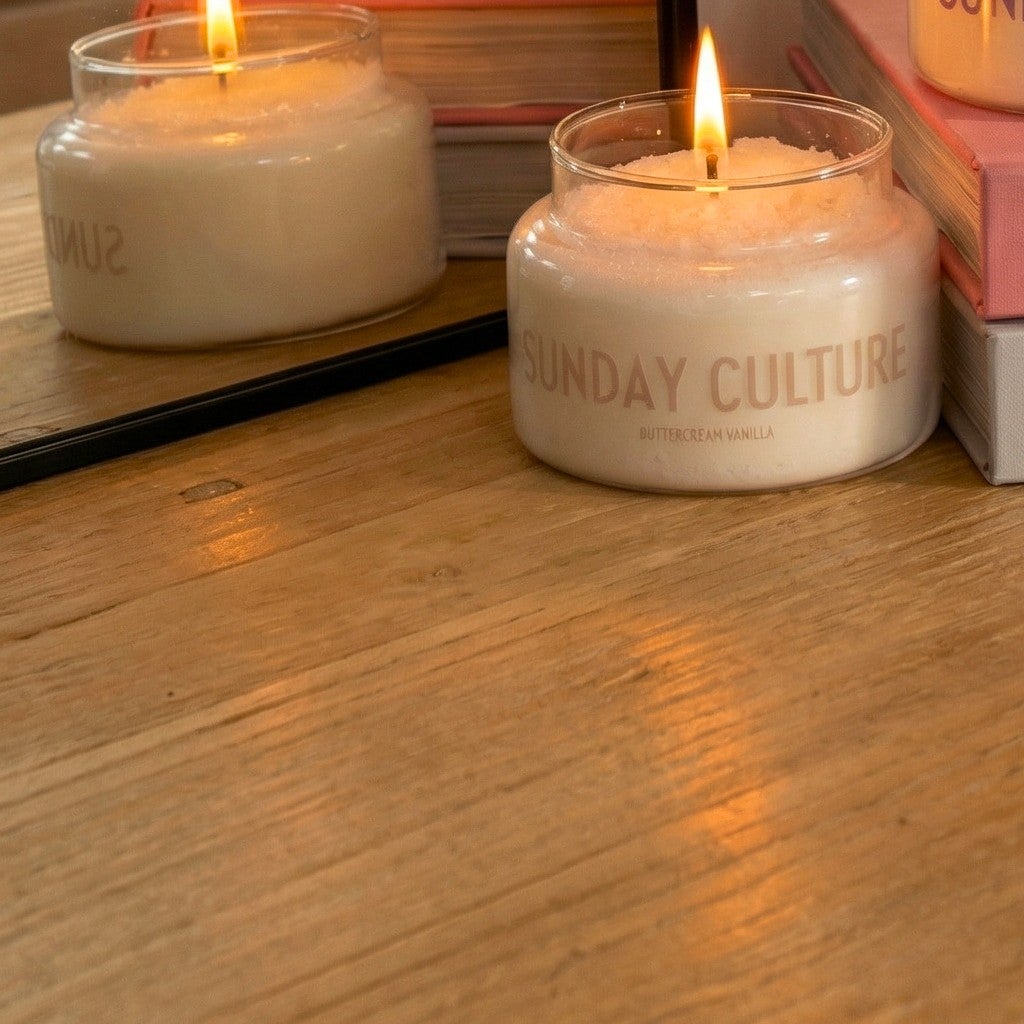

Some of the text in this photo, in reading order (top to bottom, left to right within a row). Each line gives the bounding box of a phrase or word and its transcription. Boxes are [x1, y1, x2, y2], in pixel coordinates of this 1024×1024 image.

[522, 323, 907, 413] SUNDAY CULTURE
[640, 424, 775, 442] BUTTERCREAM VANILLA
